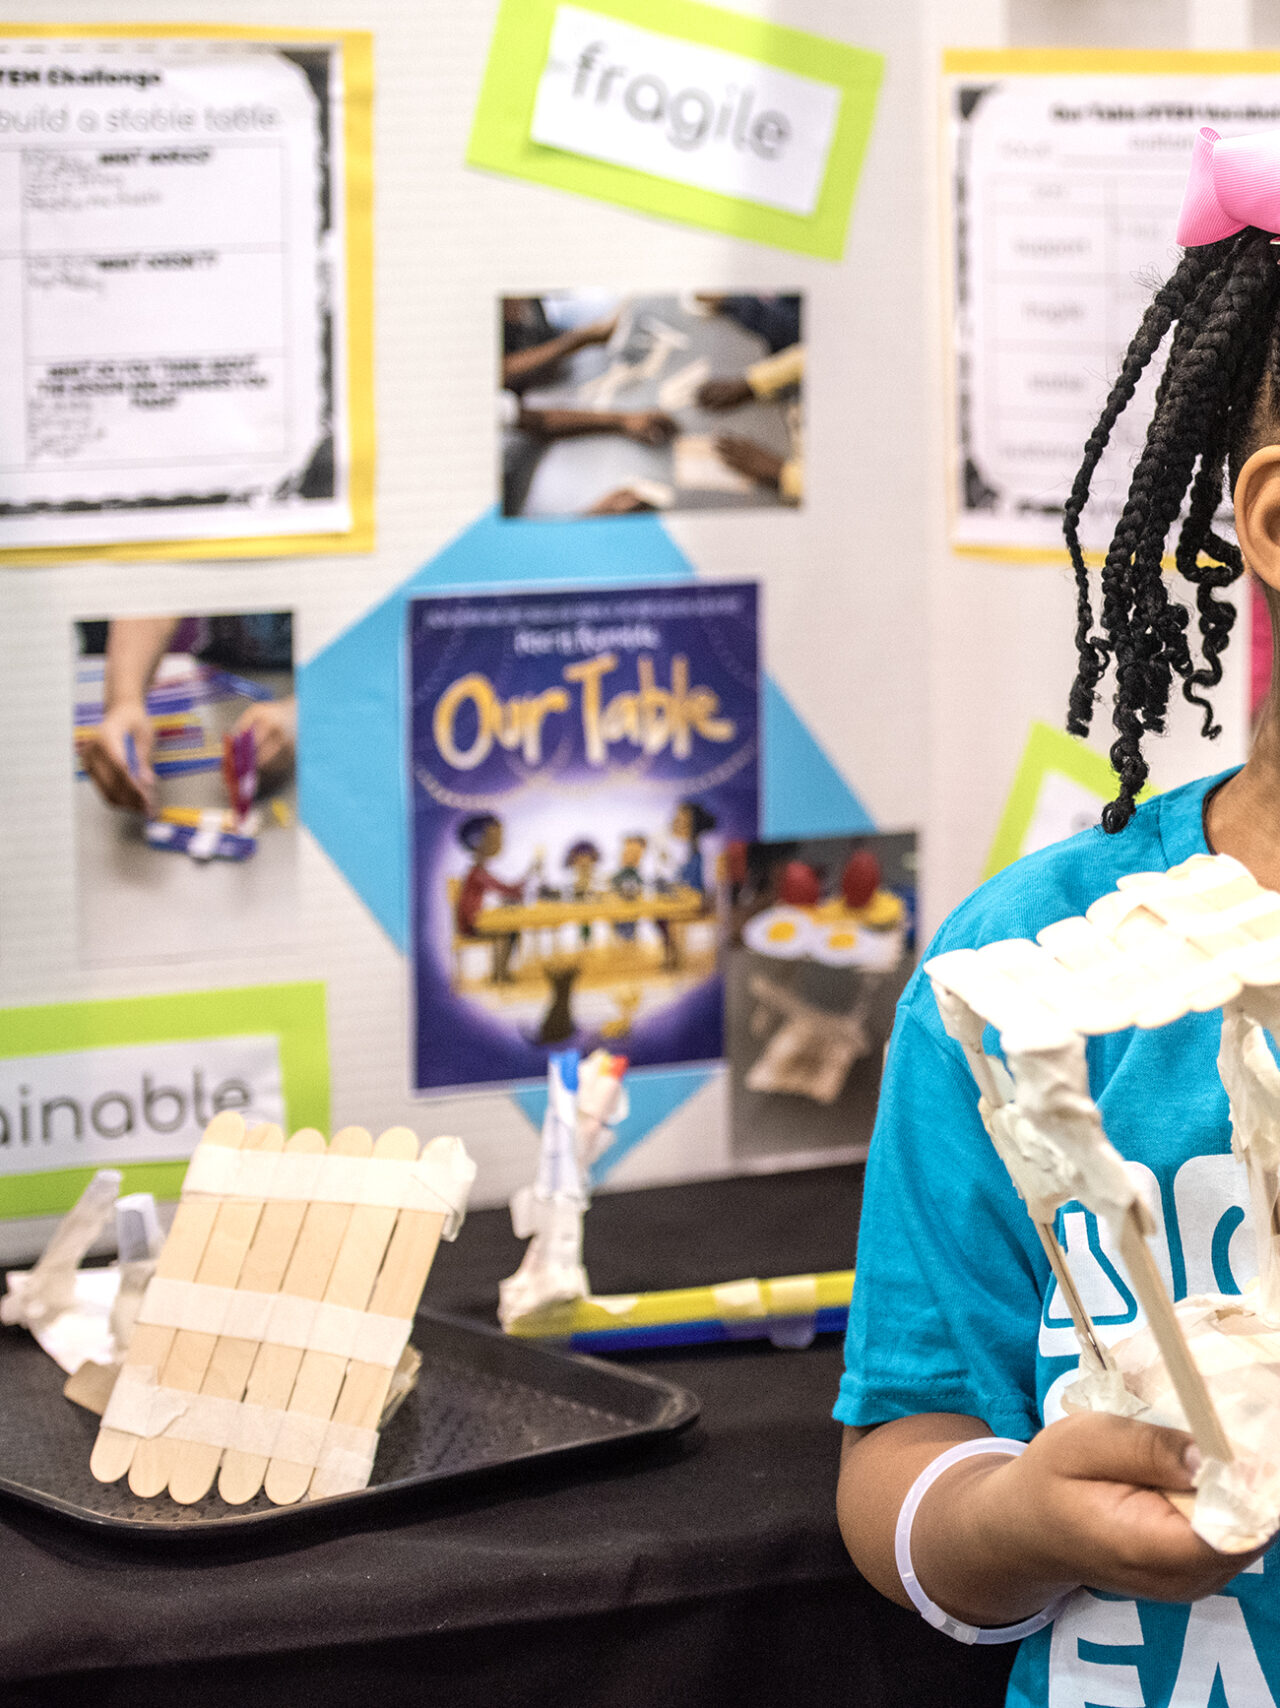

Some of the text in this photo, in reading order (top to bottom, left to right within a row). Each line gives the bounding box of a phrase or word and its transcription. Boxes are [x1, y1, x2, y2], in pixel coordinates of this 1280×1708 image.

[571, 40, 793, 162] fragile
[432, 651, 737, 771] Our Table
[0, 1066, 253, 1147] inable
